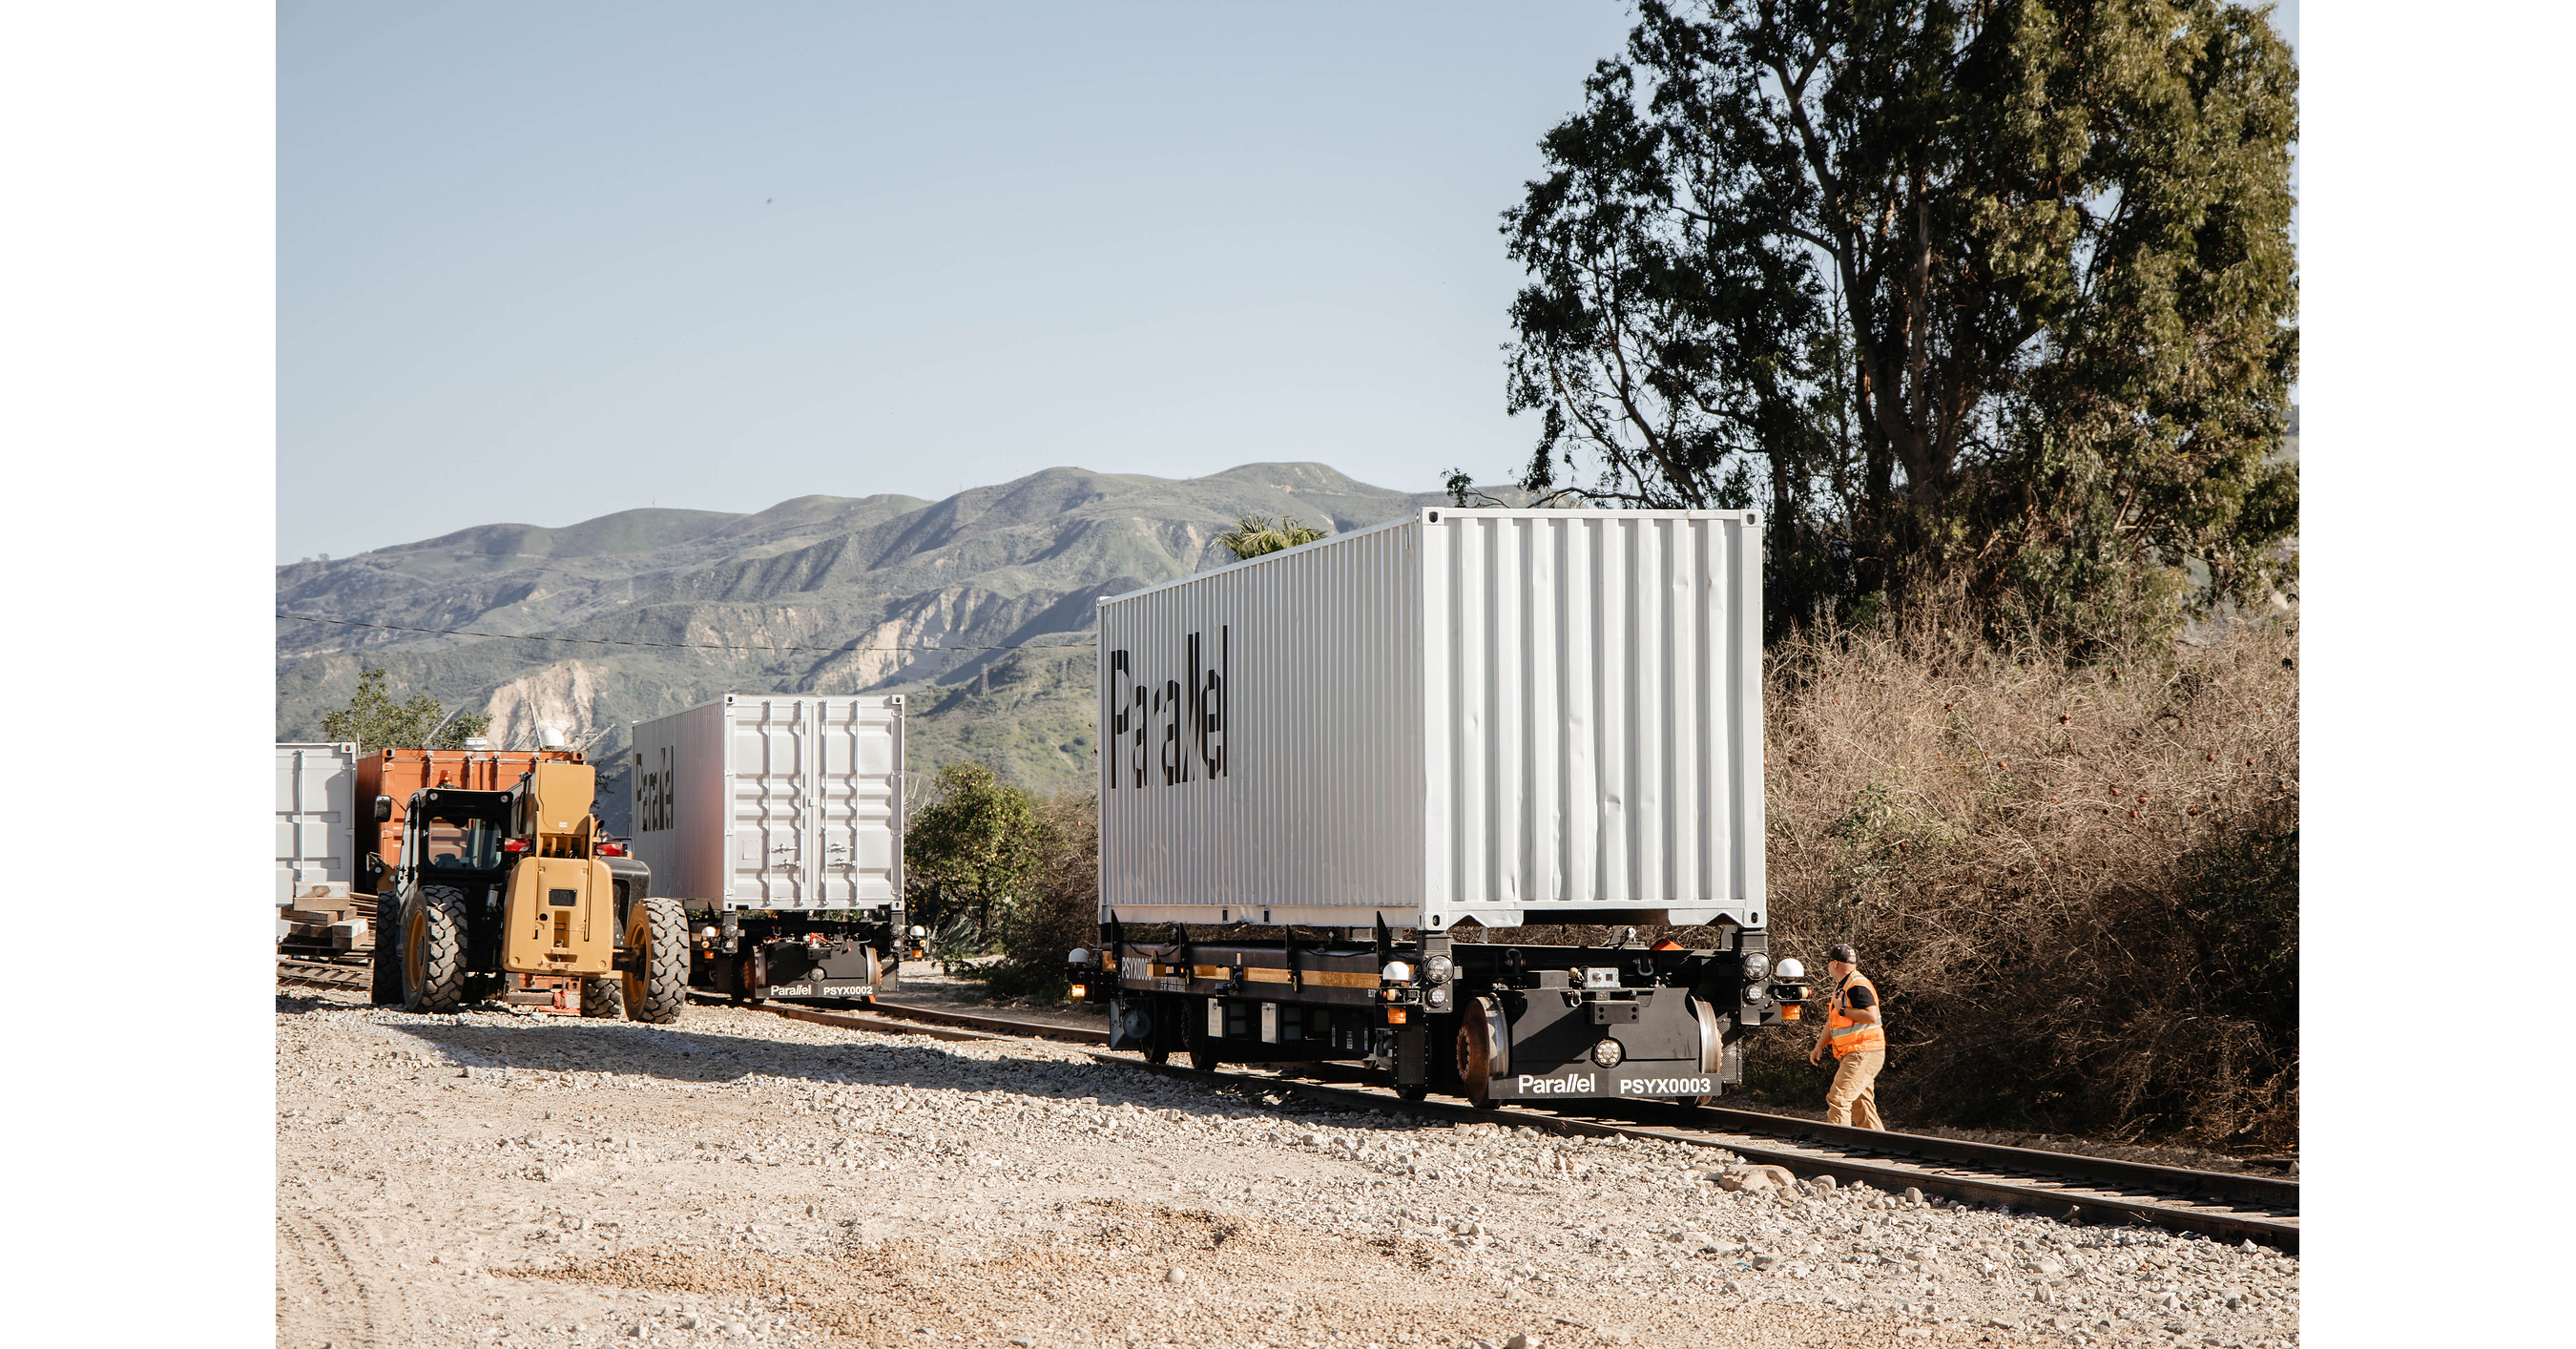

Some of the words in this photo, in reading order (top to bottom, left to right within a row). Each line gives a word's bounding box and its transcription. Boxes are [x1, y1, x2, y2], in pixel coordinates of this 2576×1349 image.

[1111, 625, 1228, 789] Parallel
[635, 745, 674, 833] Parallel
[770, 984, 812, 996] Parallel
[823, 986, 873, 995] PSYX0002
[1518, 1072, 1596, 1094] Parallel
[1620, 1077, 1712, 1094] PSYX0003
